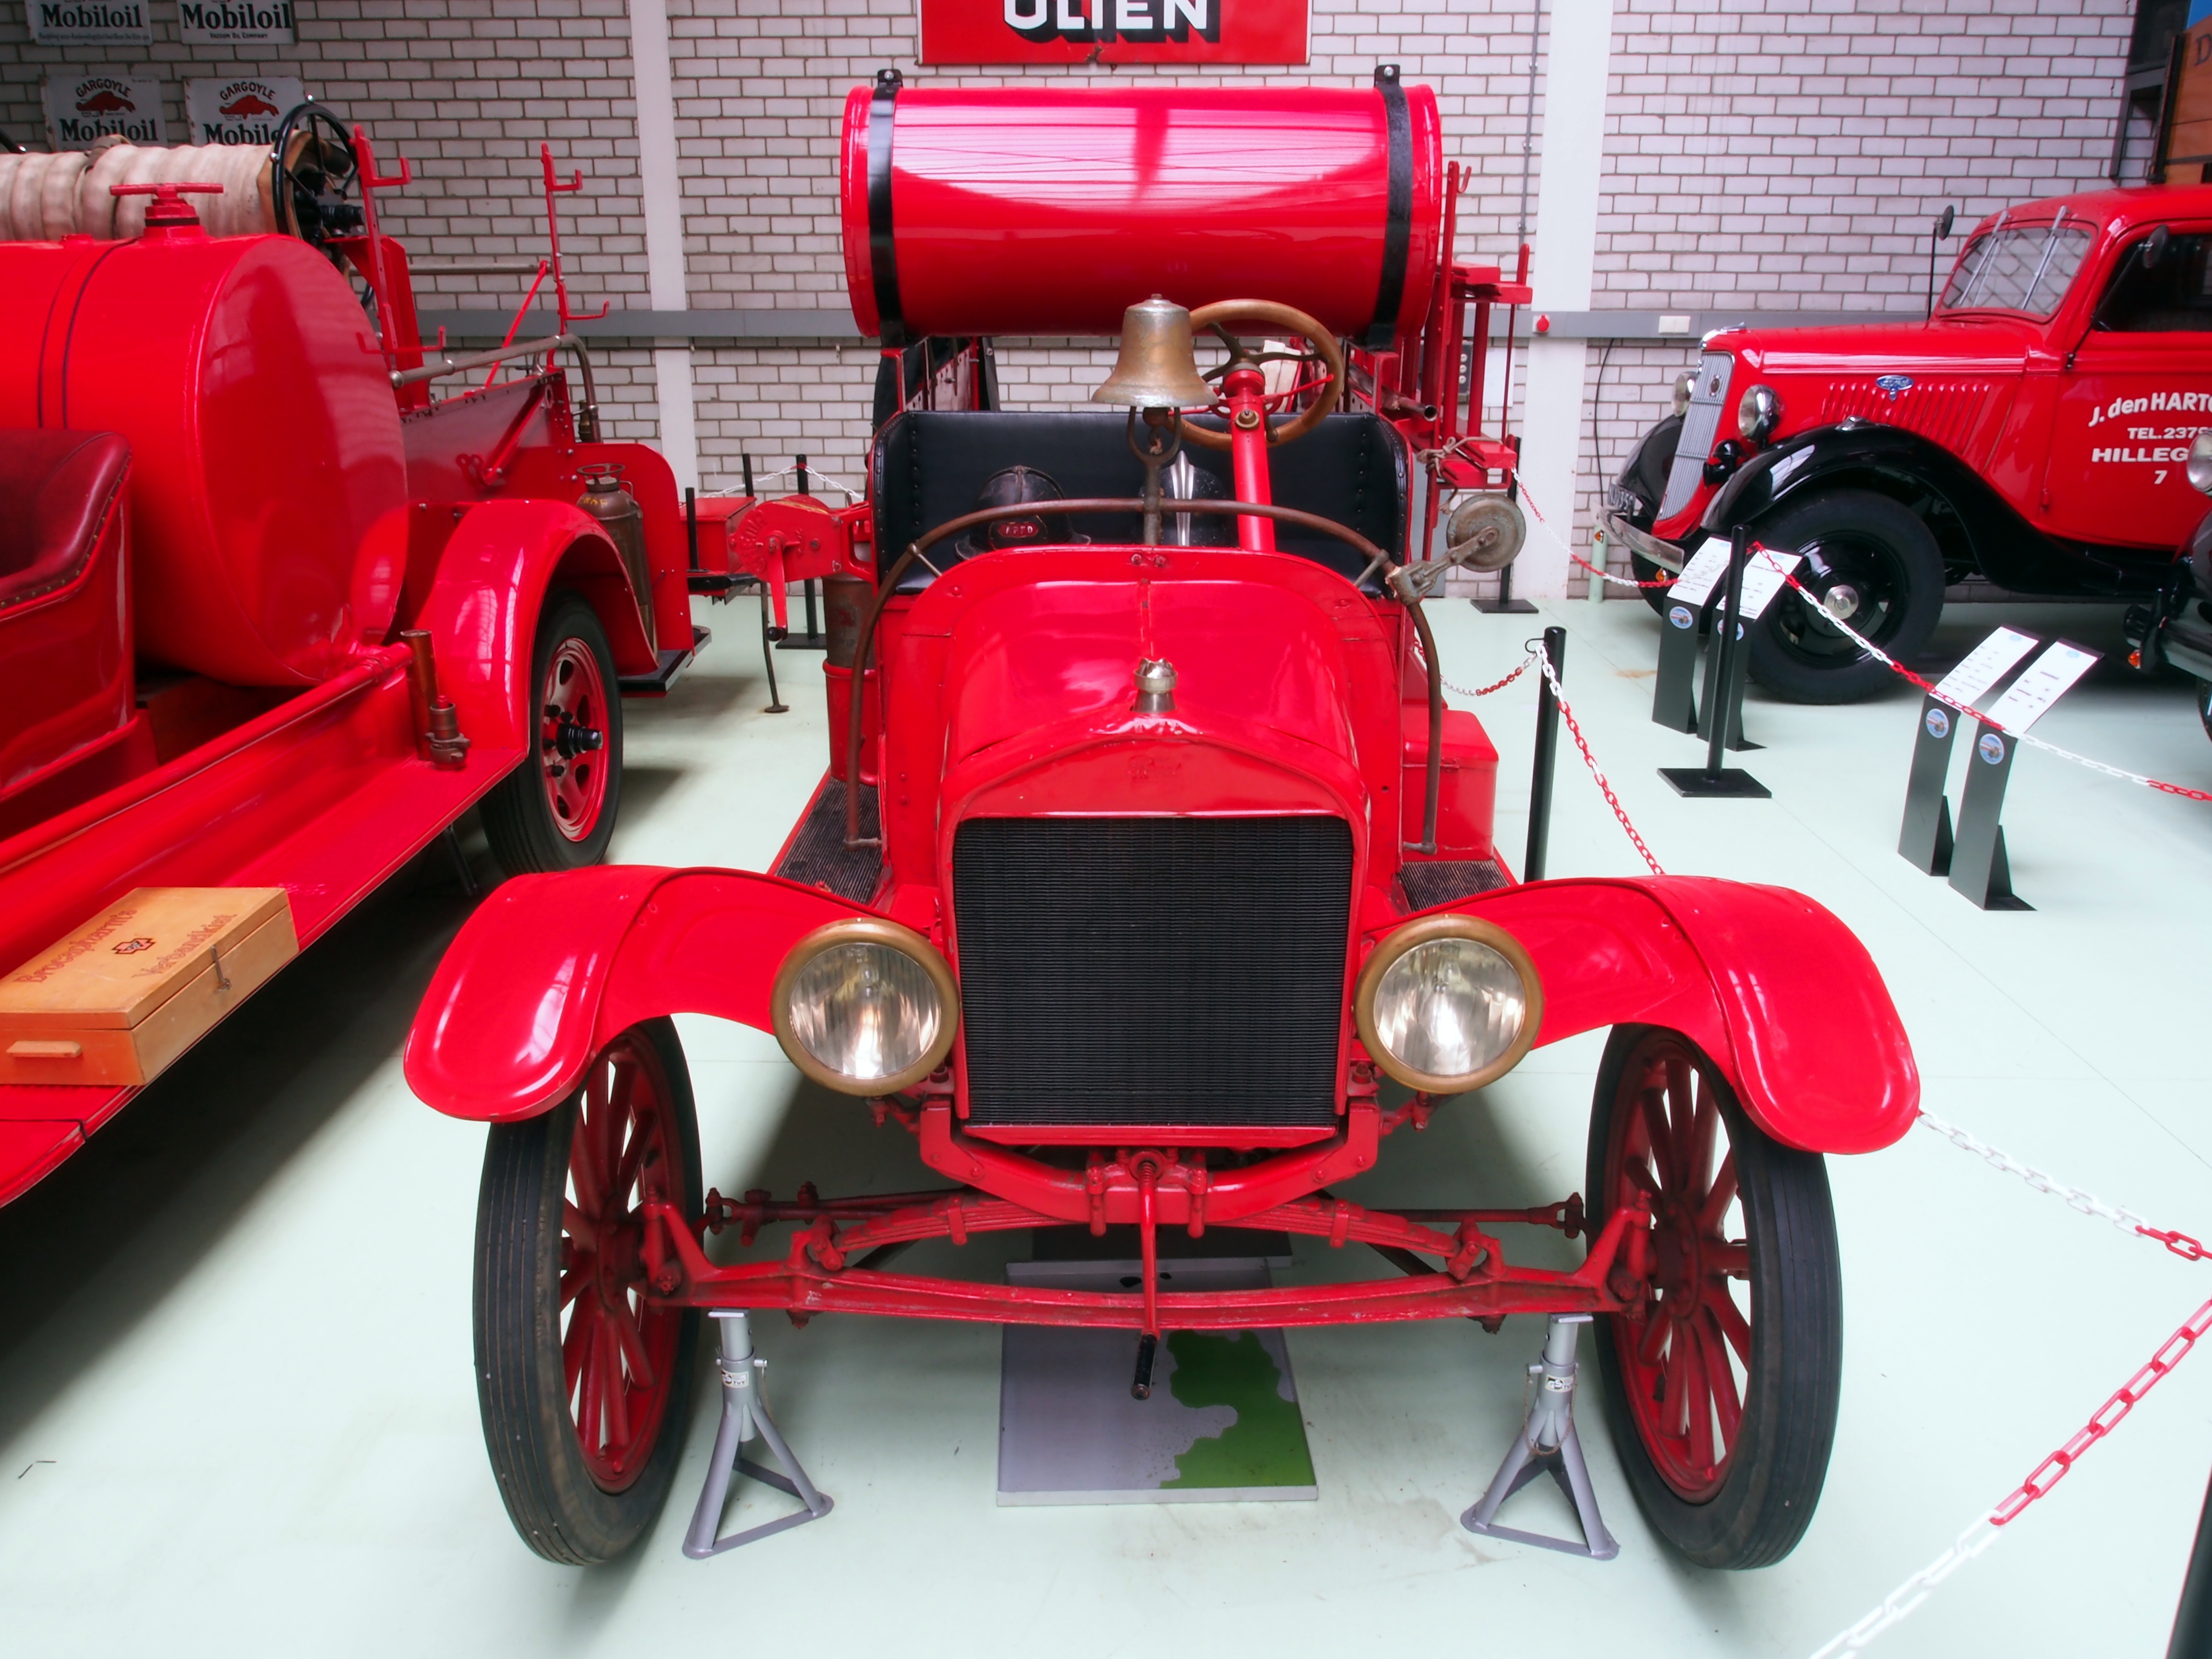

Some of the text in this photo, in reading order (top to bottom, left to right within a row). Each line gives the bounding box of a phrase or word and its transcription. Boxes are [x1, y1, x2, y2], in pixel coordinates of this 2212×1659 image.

[41, 4, 143, 27] Mobiloil
[181, 3, 292, 29] Mobiloil
[76, 78, 132, 98] GARGOYLE
[220, 81, 276, 101] GARGOYLE
[59, 118, 158, 141] Mobiloil
[203, 123, 299, 145] Mobilo
[2088, 392, 2212, 427] J. den HART
[2154, 469, 2168, 485] 7
